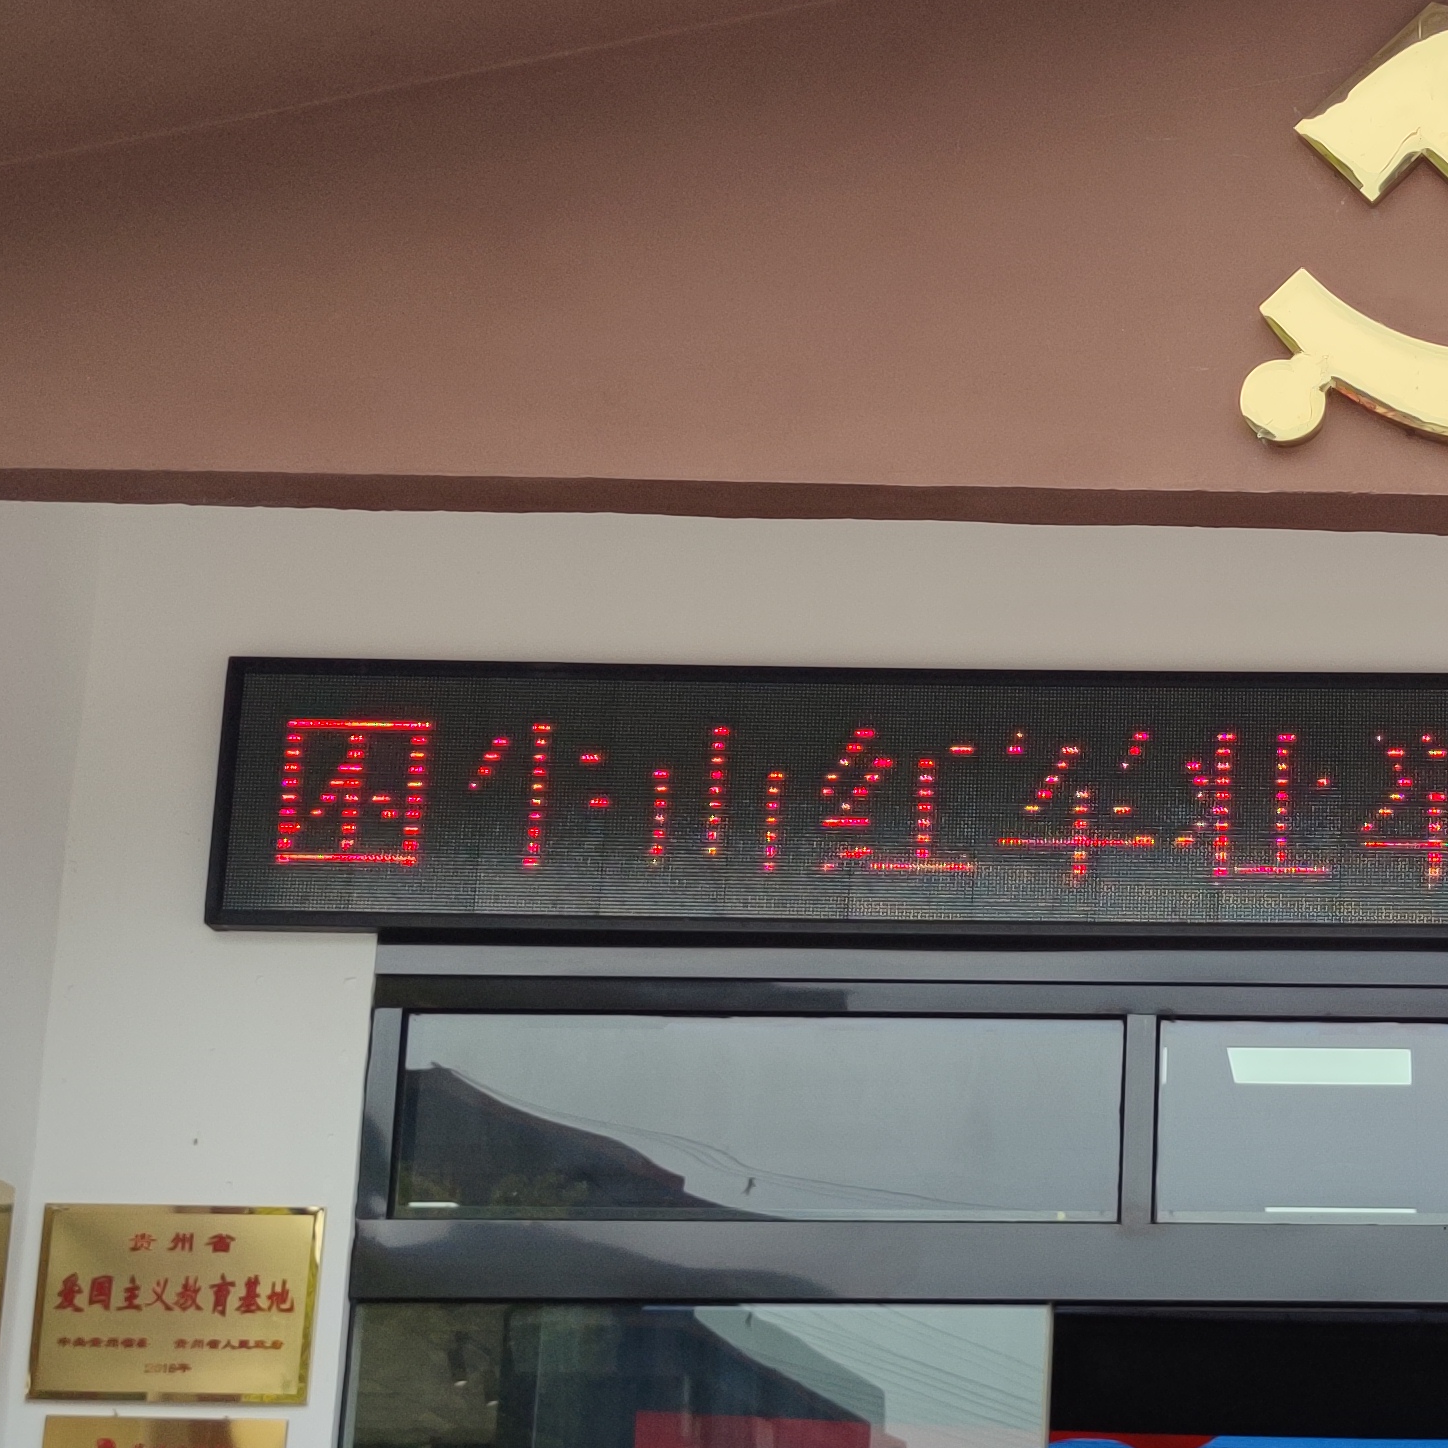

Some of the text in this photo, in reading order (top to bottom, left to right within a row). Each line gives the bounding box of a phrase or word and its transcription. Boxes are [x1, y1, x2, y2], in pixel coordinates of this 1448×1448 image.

[128, 1232, 237, 1253] 贵州省
[53, 1271, 295, 1317] 爱国主义教育基地
